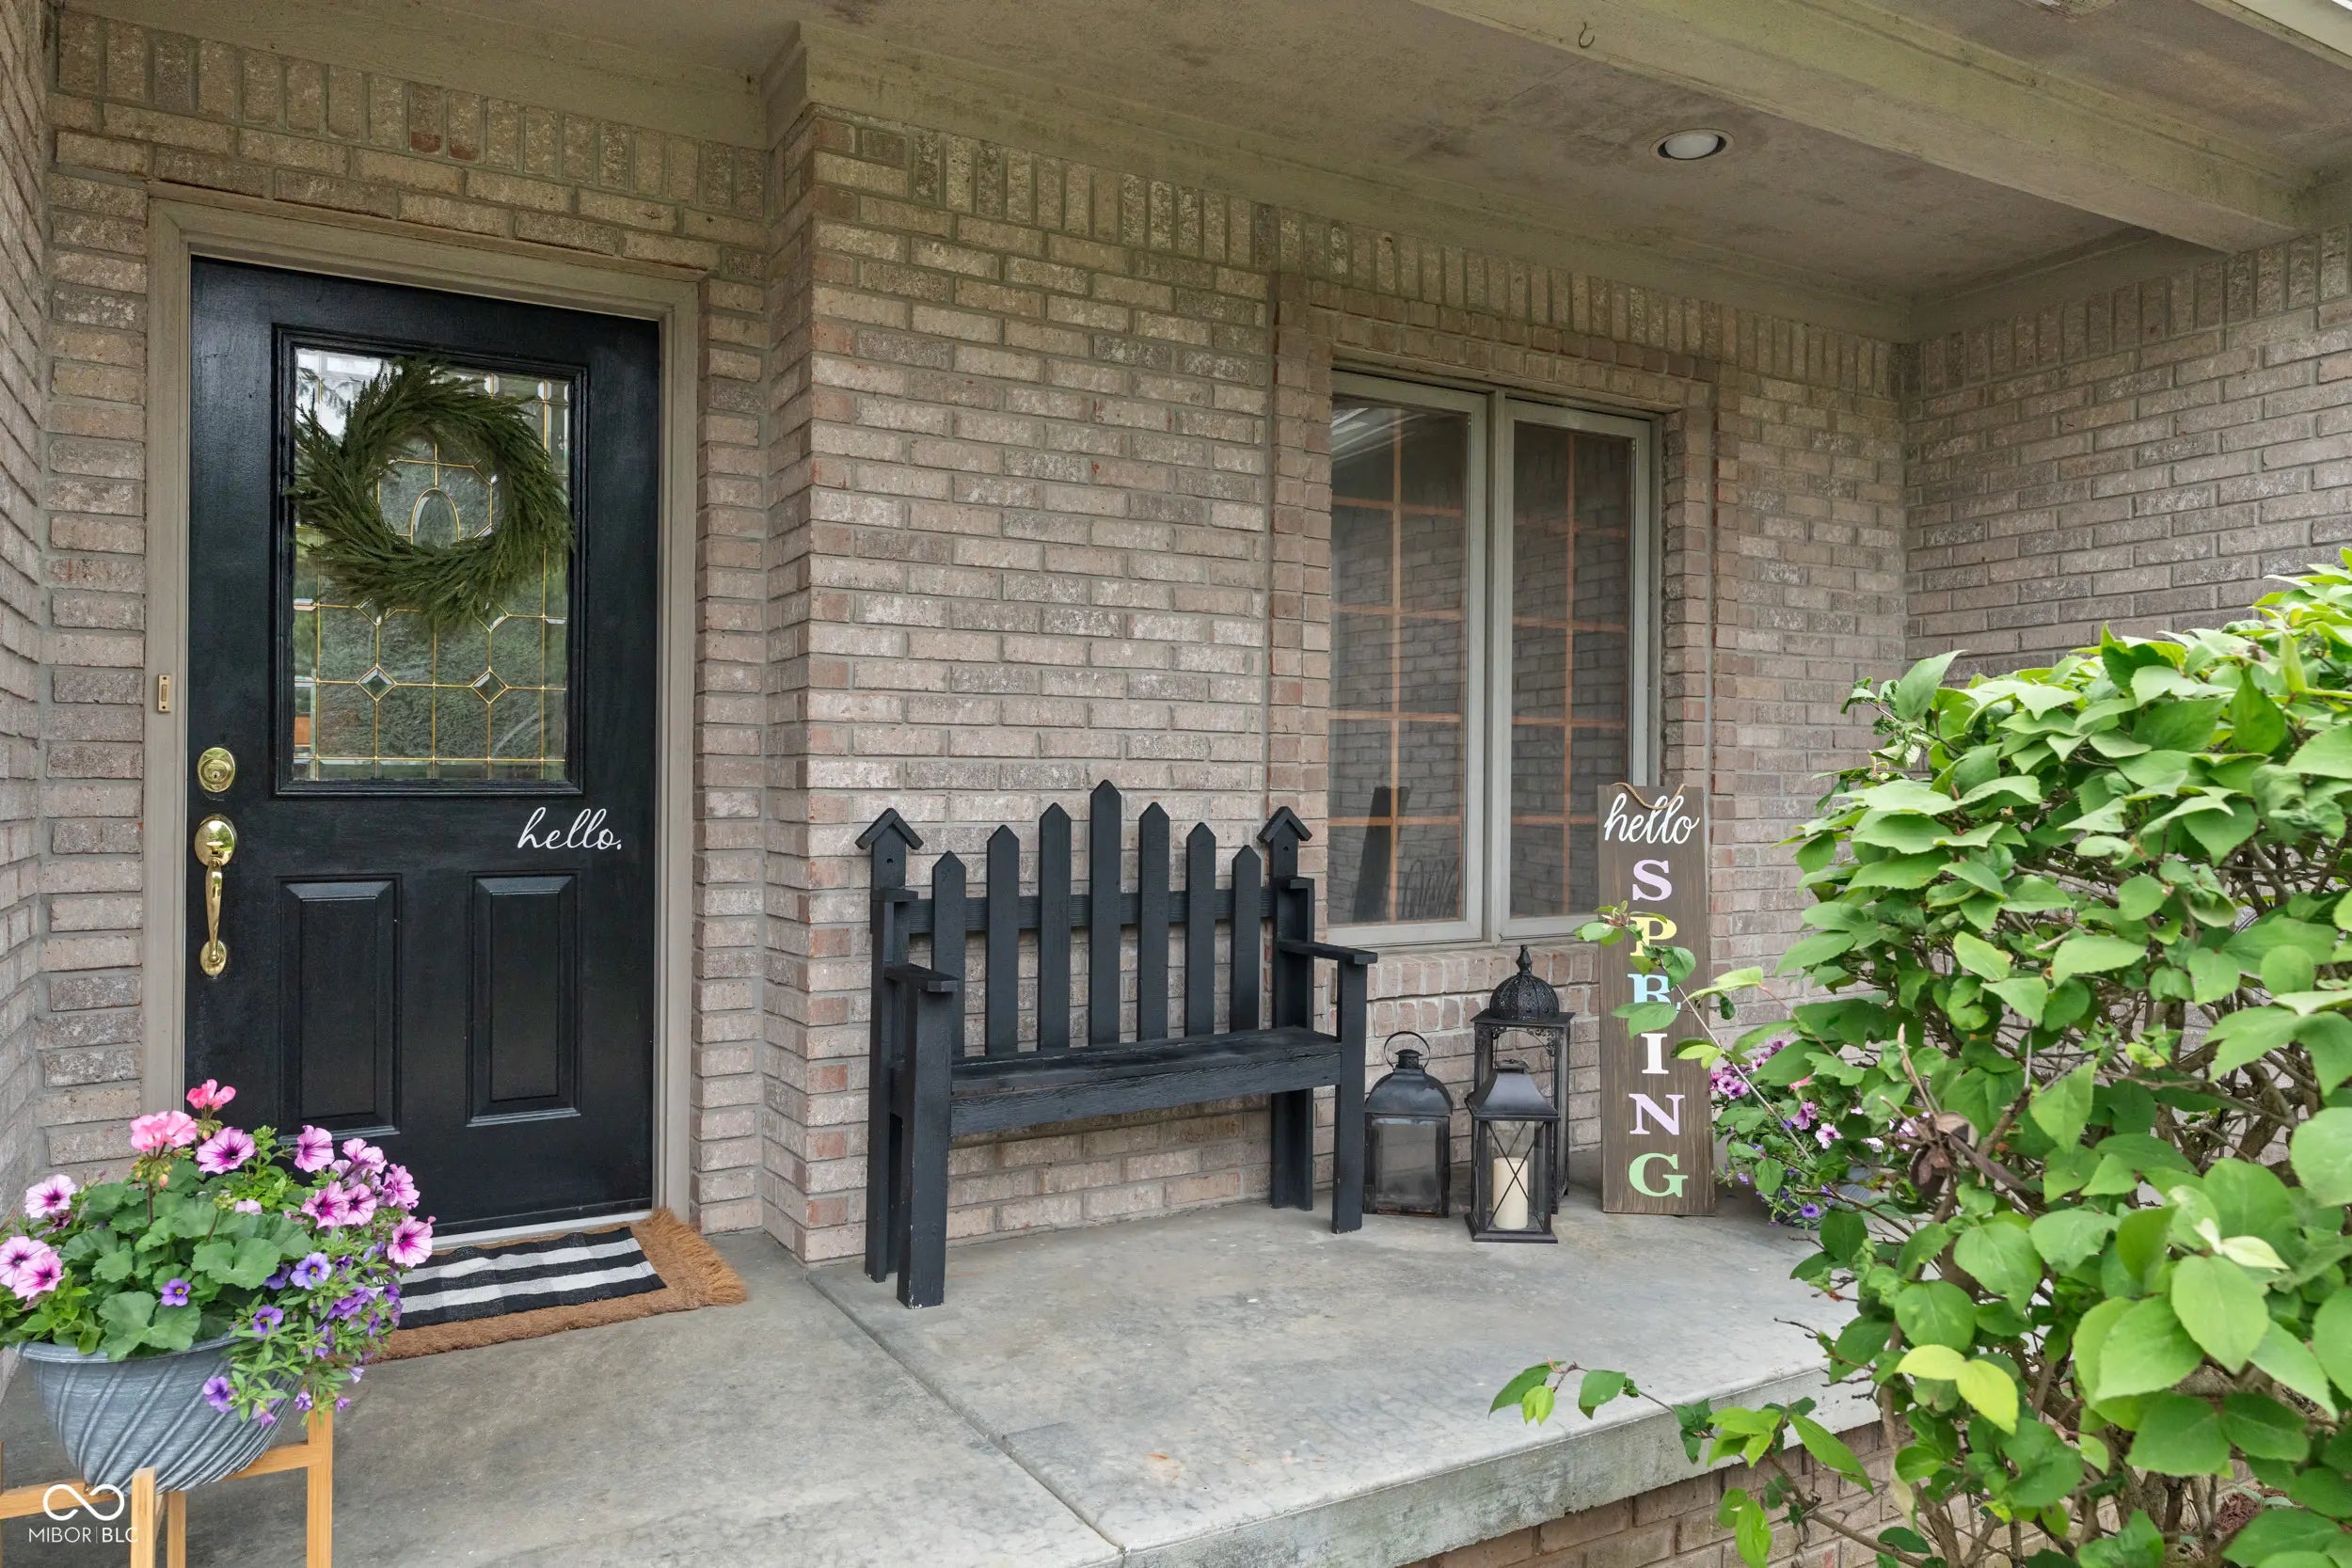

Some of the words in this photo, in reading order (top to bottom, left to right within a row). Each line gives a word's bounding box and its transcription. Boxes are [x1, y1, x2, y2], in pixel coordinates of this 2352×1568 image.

[517, 806, 622, 850] hello.
[1603, 792, 1700, 845] hello
[1627, 859, 1689, 1198] SPRING
